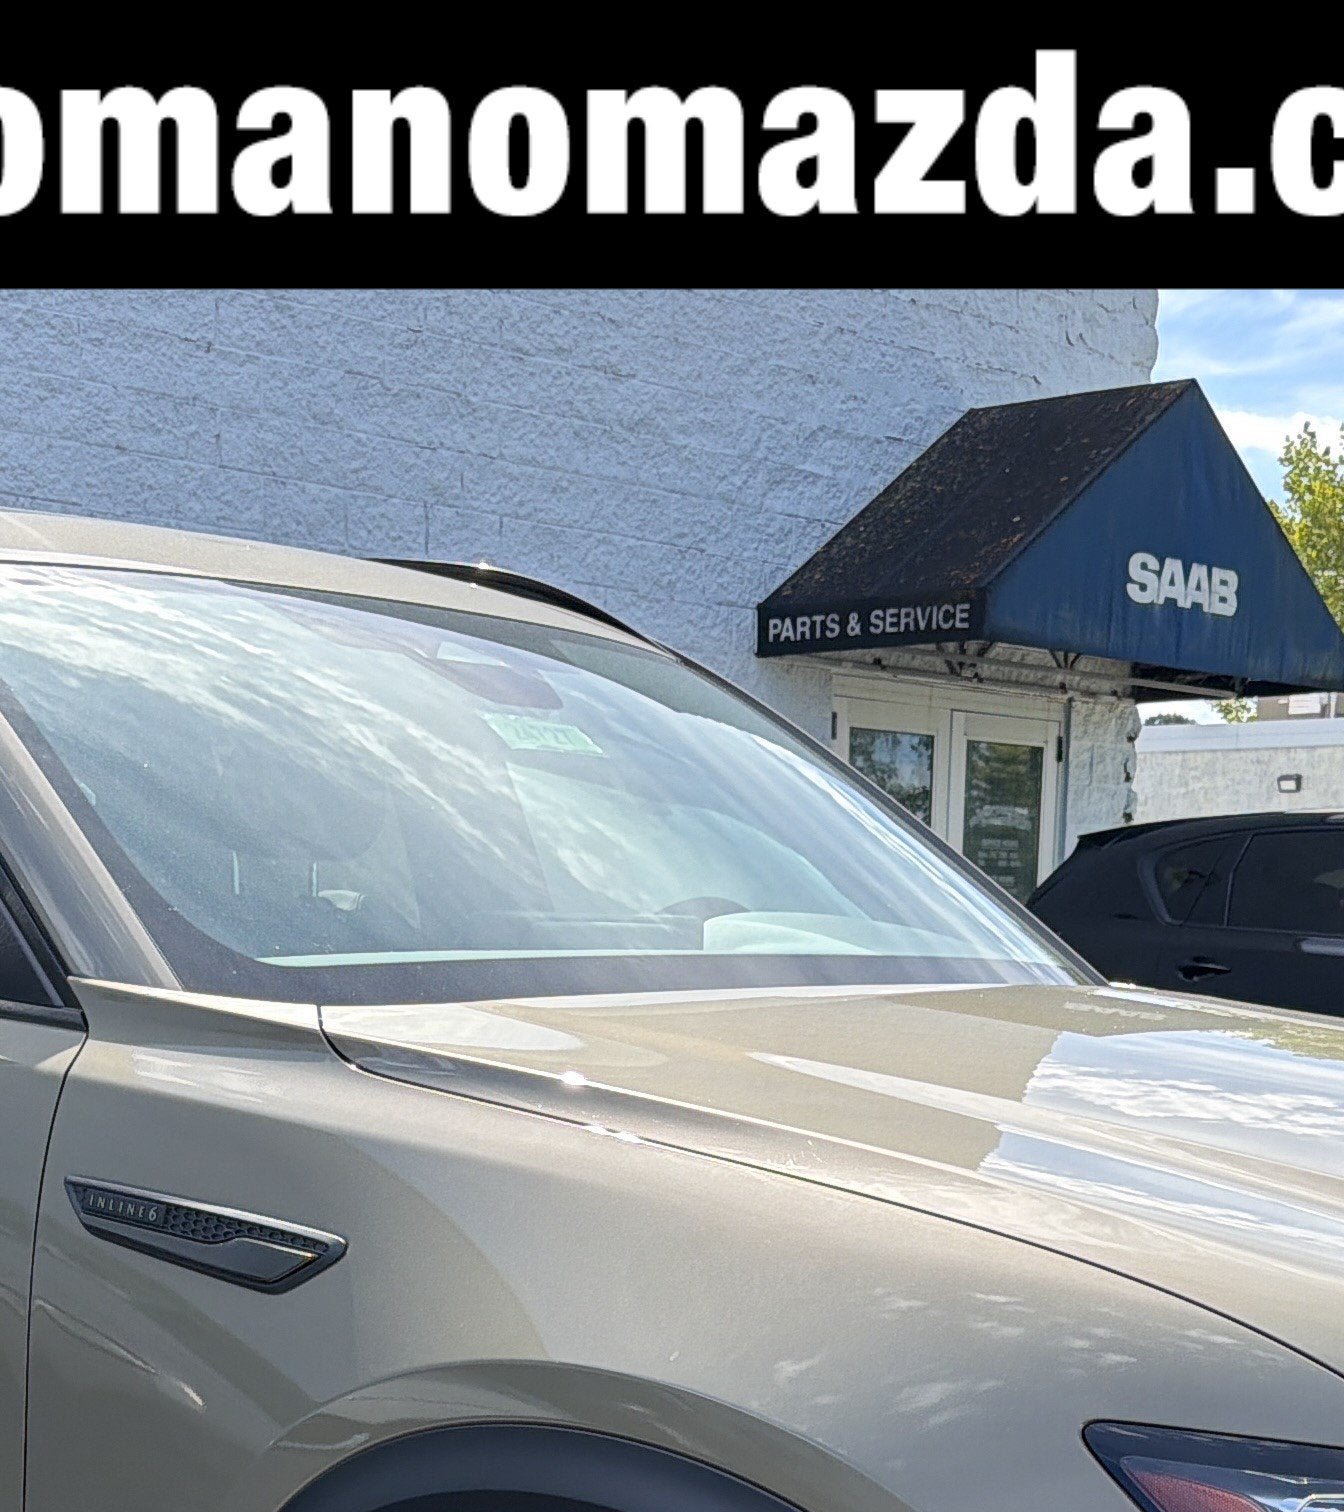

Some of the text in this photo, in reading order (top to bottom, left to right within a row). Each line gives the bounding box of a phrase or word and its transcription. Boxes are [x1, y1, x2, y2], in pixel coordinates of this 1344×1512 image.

[1126, 552, 1239, 617] SAAB
[768, 603, 971, 643] PARTS & SERVICE
